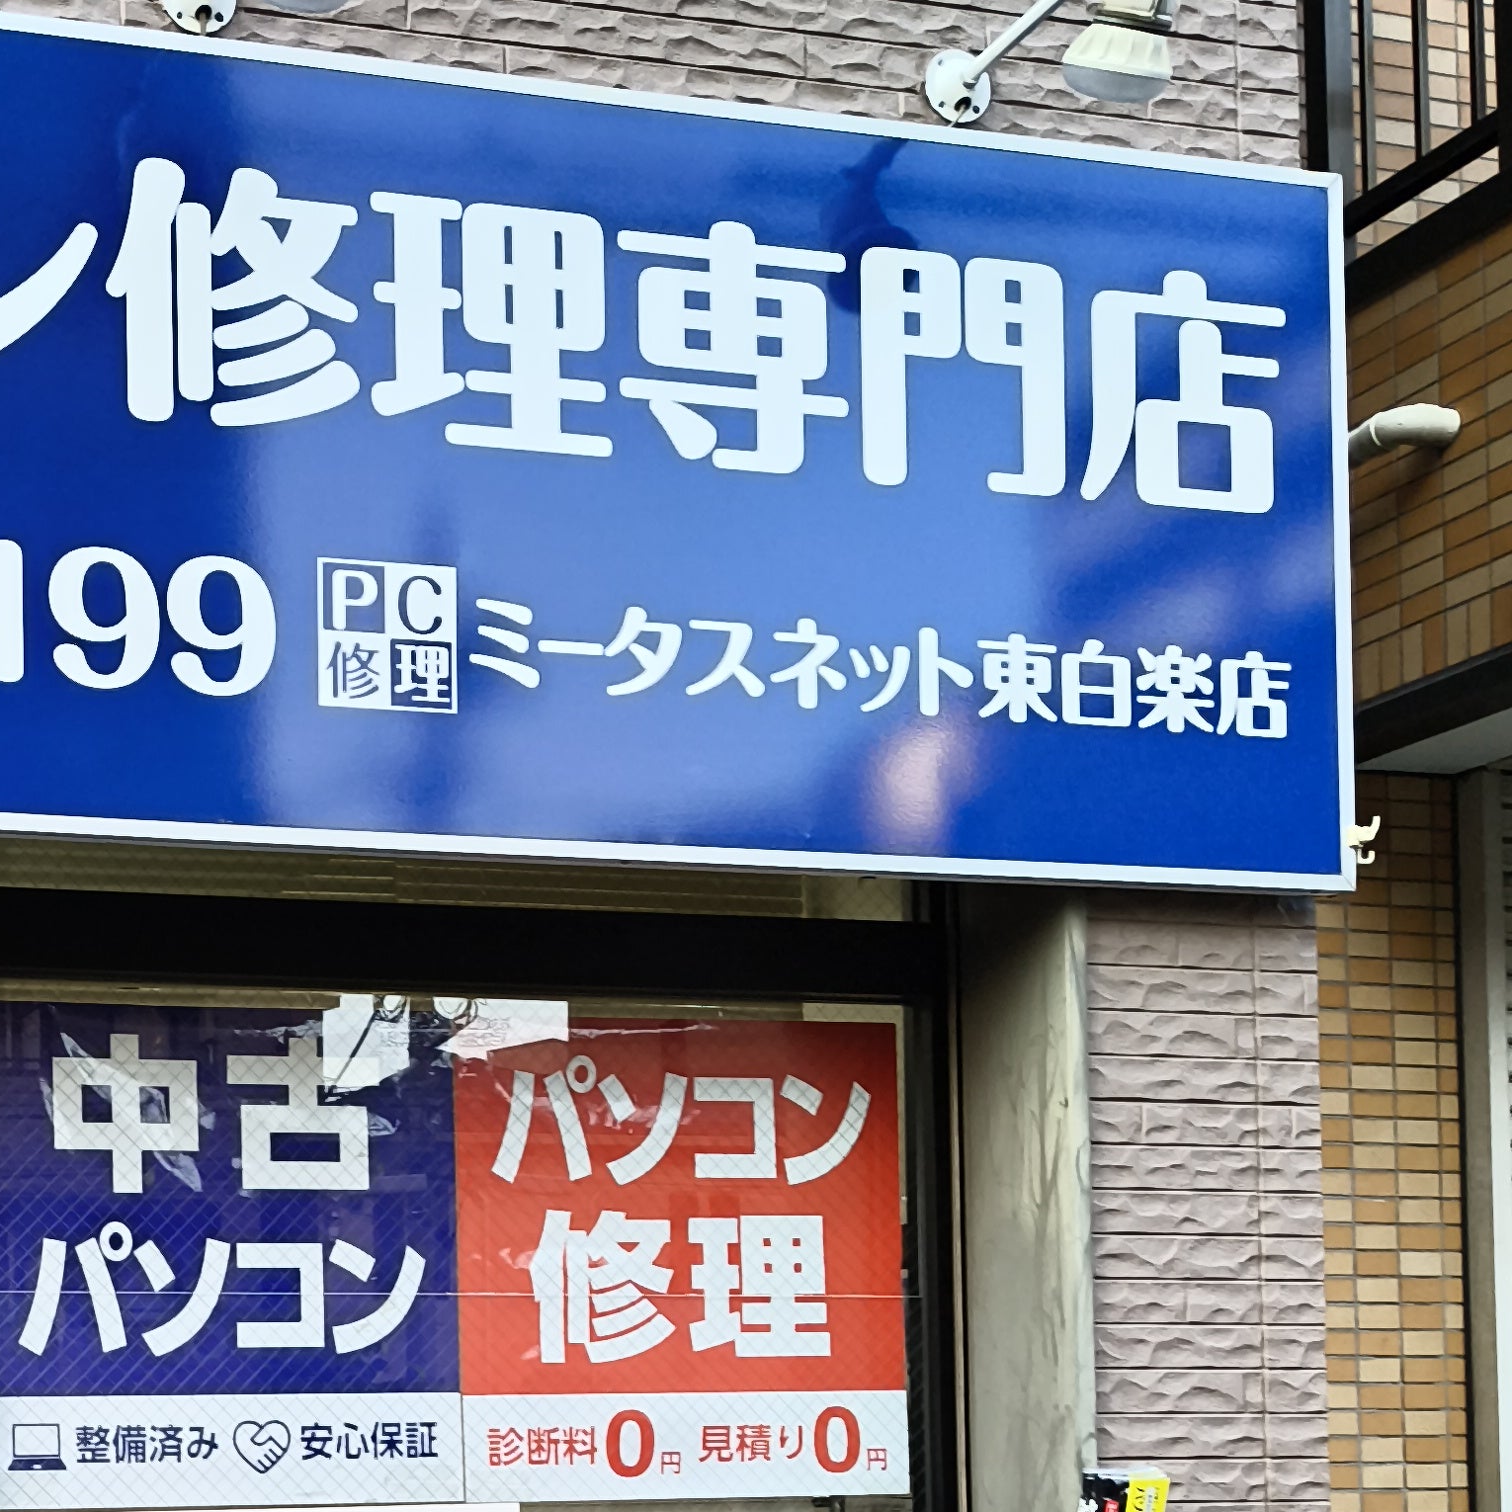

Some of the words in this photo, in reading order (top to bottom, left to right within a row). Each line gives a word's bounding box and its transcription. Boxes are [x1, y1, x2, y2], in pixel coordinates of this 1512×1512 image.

[329, 567, 445, 637] PC
[468, 597, 1292, 739] ミータスネット東白楽店
[325, 640, 454, 706] 修理
[52, 1033, 381, 1194] 中古
[491, 1054, 872, 1186] パソコン
[18, 1221, 426, 1356] パソコン
[529, 1209, 832, 1364] 修理
[75, 1425, 219, 1465] 整備済み
[300, 1420, 438, 1462] 安心保証
